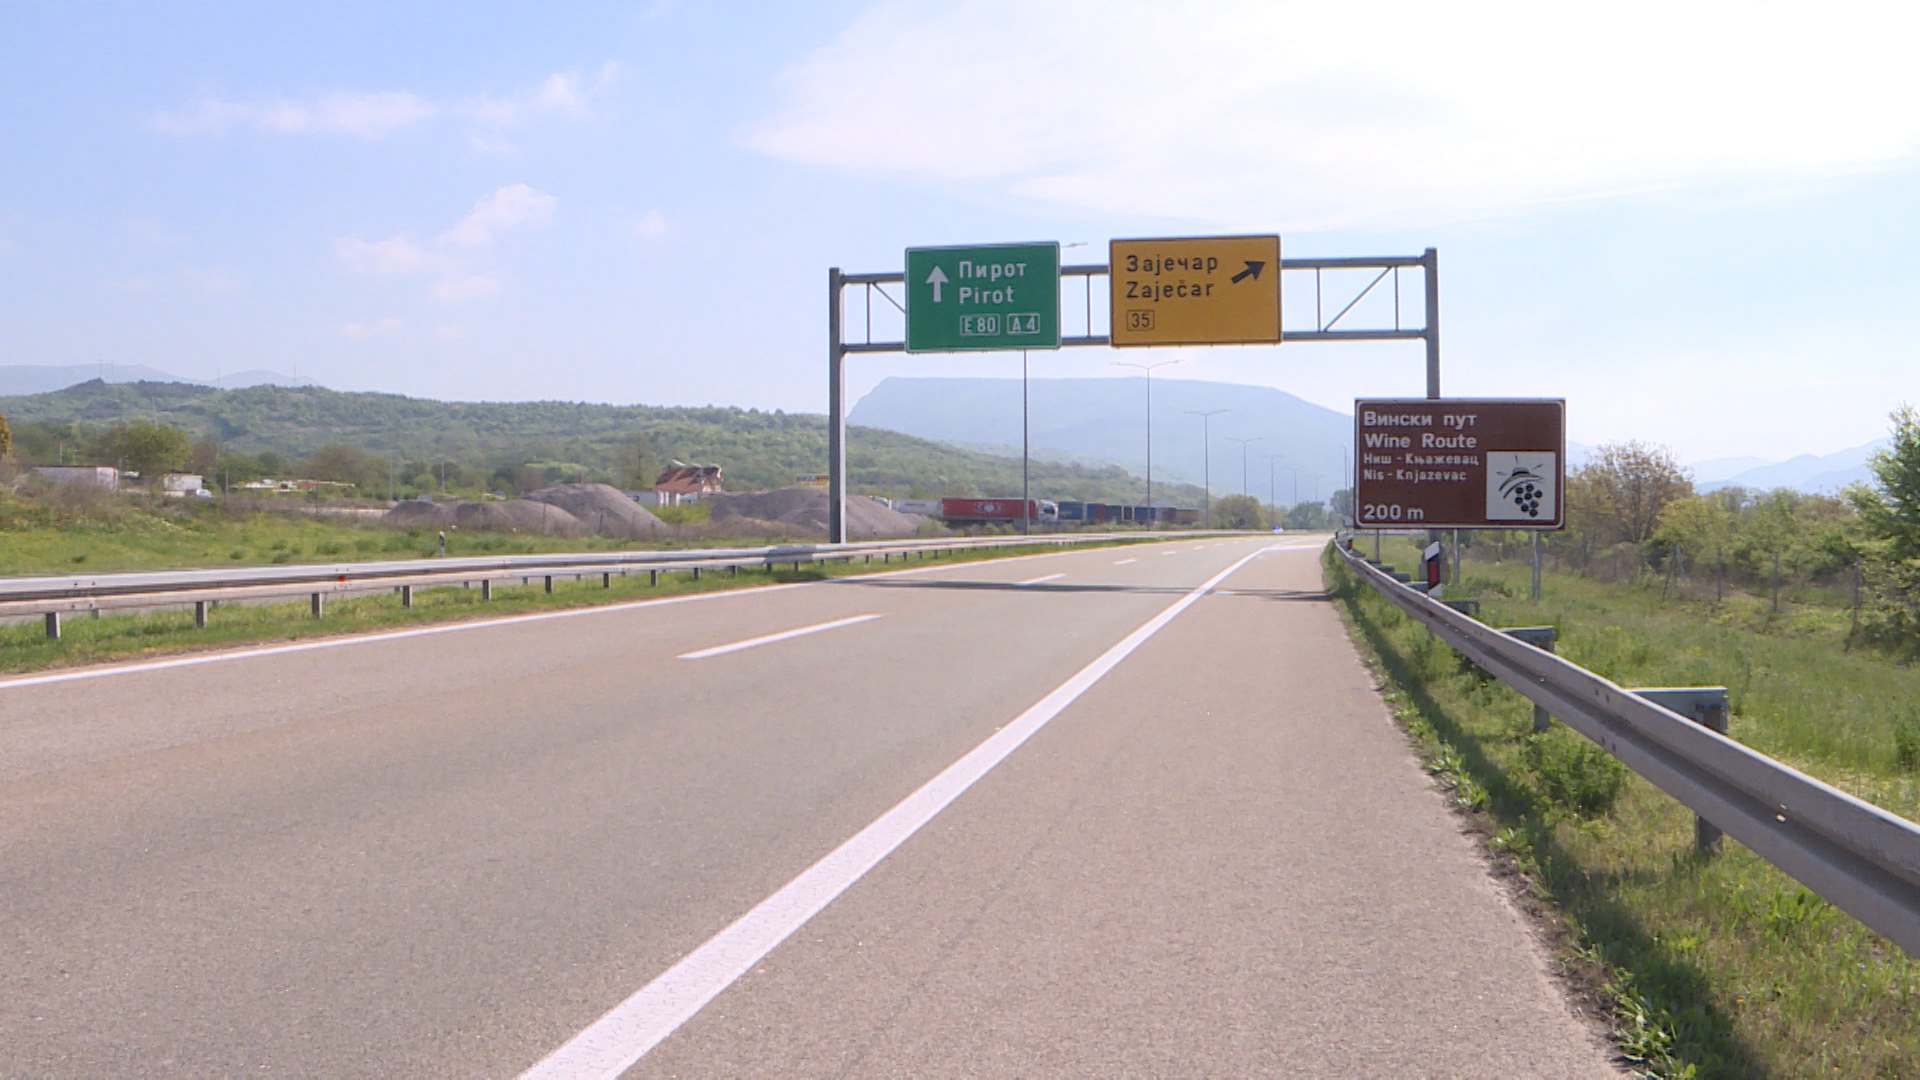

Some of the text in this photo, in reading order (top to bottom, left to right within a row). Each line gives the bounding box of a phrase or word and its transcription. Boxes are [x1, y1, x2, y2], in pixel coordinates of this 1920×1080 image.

[959, 261, 1027, 281] Пирот
[1126, 254, 1218, 276] Зајечар
[959, 286, 1014, 304] Pirot
[1126, 280, 1214, 302] Zaječar
[965, 317, 996, 332] E 80
[1012, 317, 1035, 331] A 4
[1131, 313, 1150, 328] 35
[1363, 411, 1478, 430] Вински пут
[1364, 433, 1477, 448] Wine Route
[1363, 454, 1392, 465] Ниш
[1405, 454, 1479, 466] Књажевац
[1363, 504, 1424, 520] 200 m
